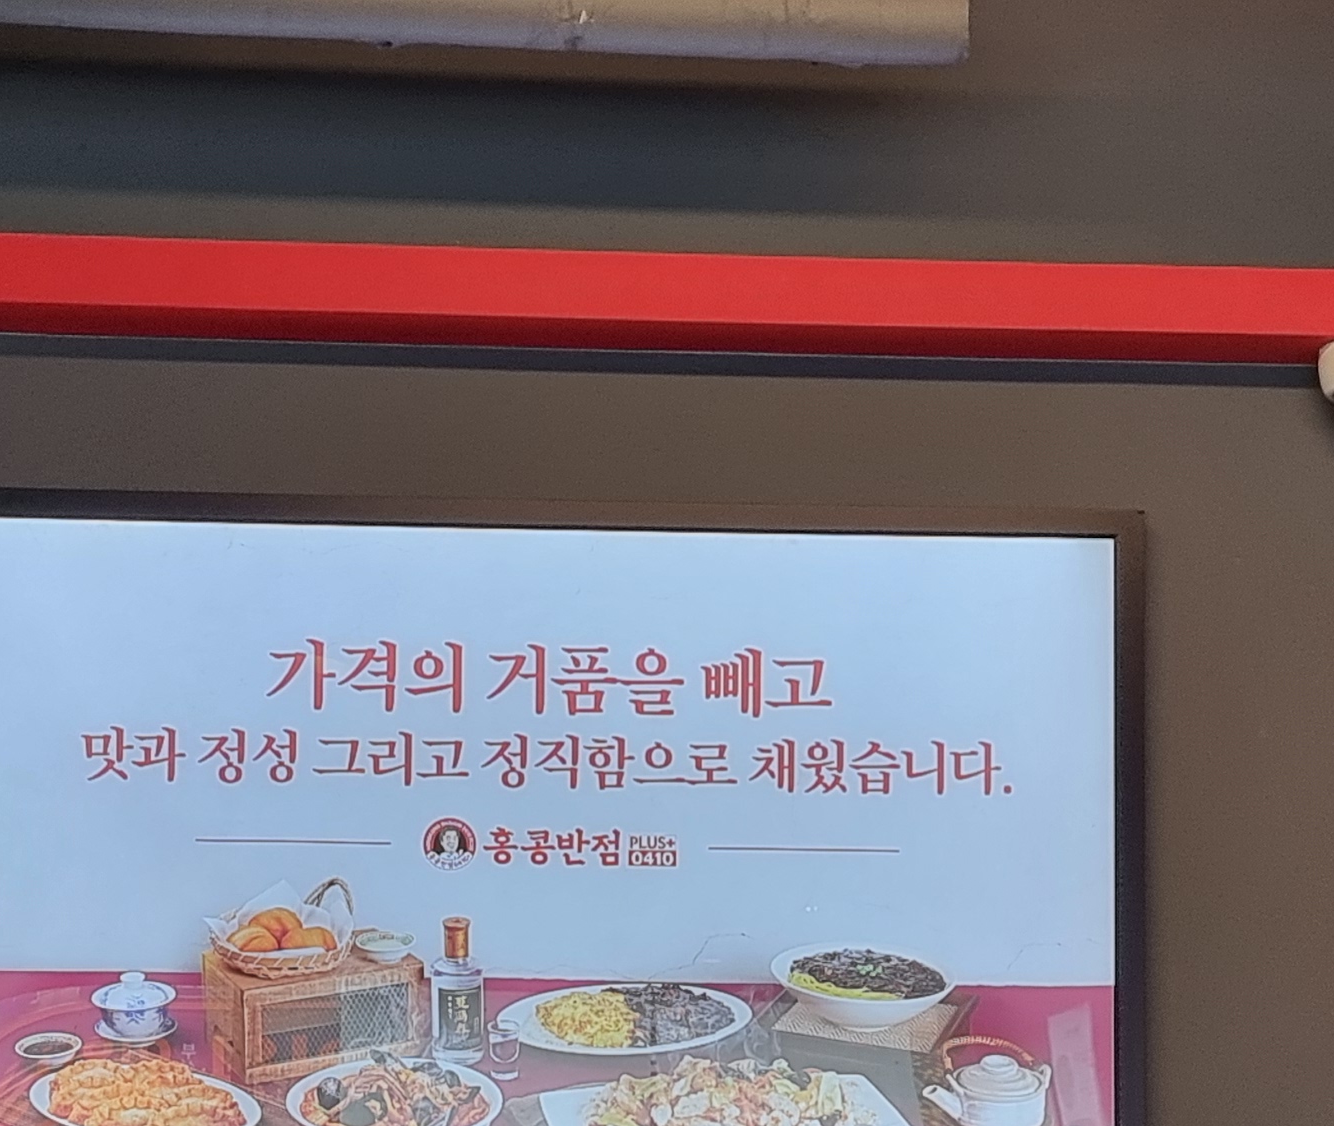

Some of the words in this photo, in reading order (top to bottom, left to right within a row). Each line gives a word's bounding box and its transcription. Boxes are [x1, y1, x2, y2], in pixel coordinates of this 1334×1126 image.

[267, 638, 464, 714] 가격의
[487, 644, 684, 716] 거품을
[701, 647, 832, 718] 빼고
[82, 725, 186, 782] 맛과
[198, 728, 297, 783] 정성
[312, 731, 469, 786] 그리고
[481, 733, 737, 790] 정직함으로
[749, 738, 1012, 796] 채웠습니다.
[483, 827, 621, 866] 홍콩반점
[629, 851, 676, 866] 0410
[630, 835, 675, 849] PLUS+
